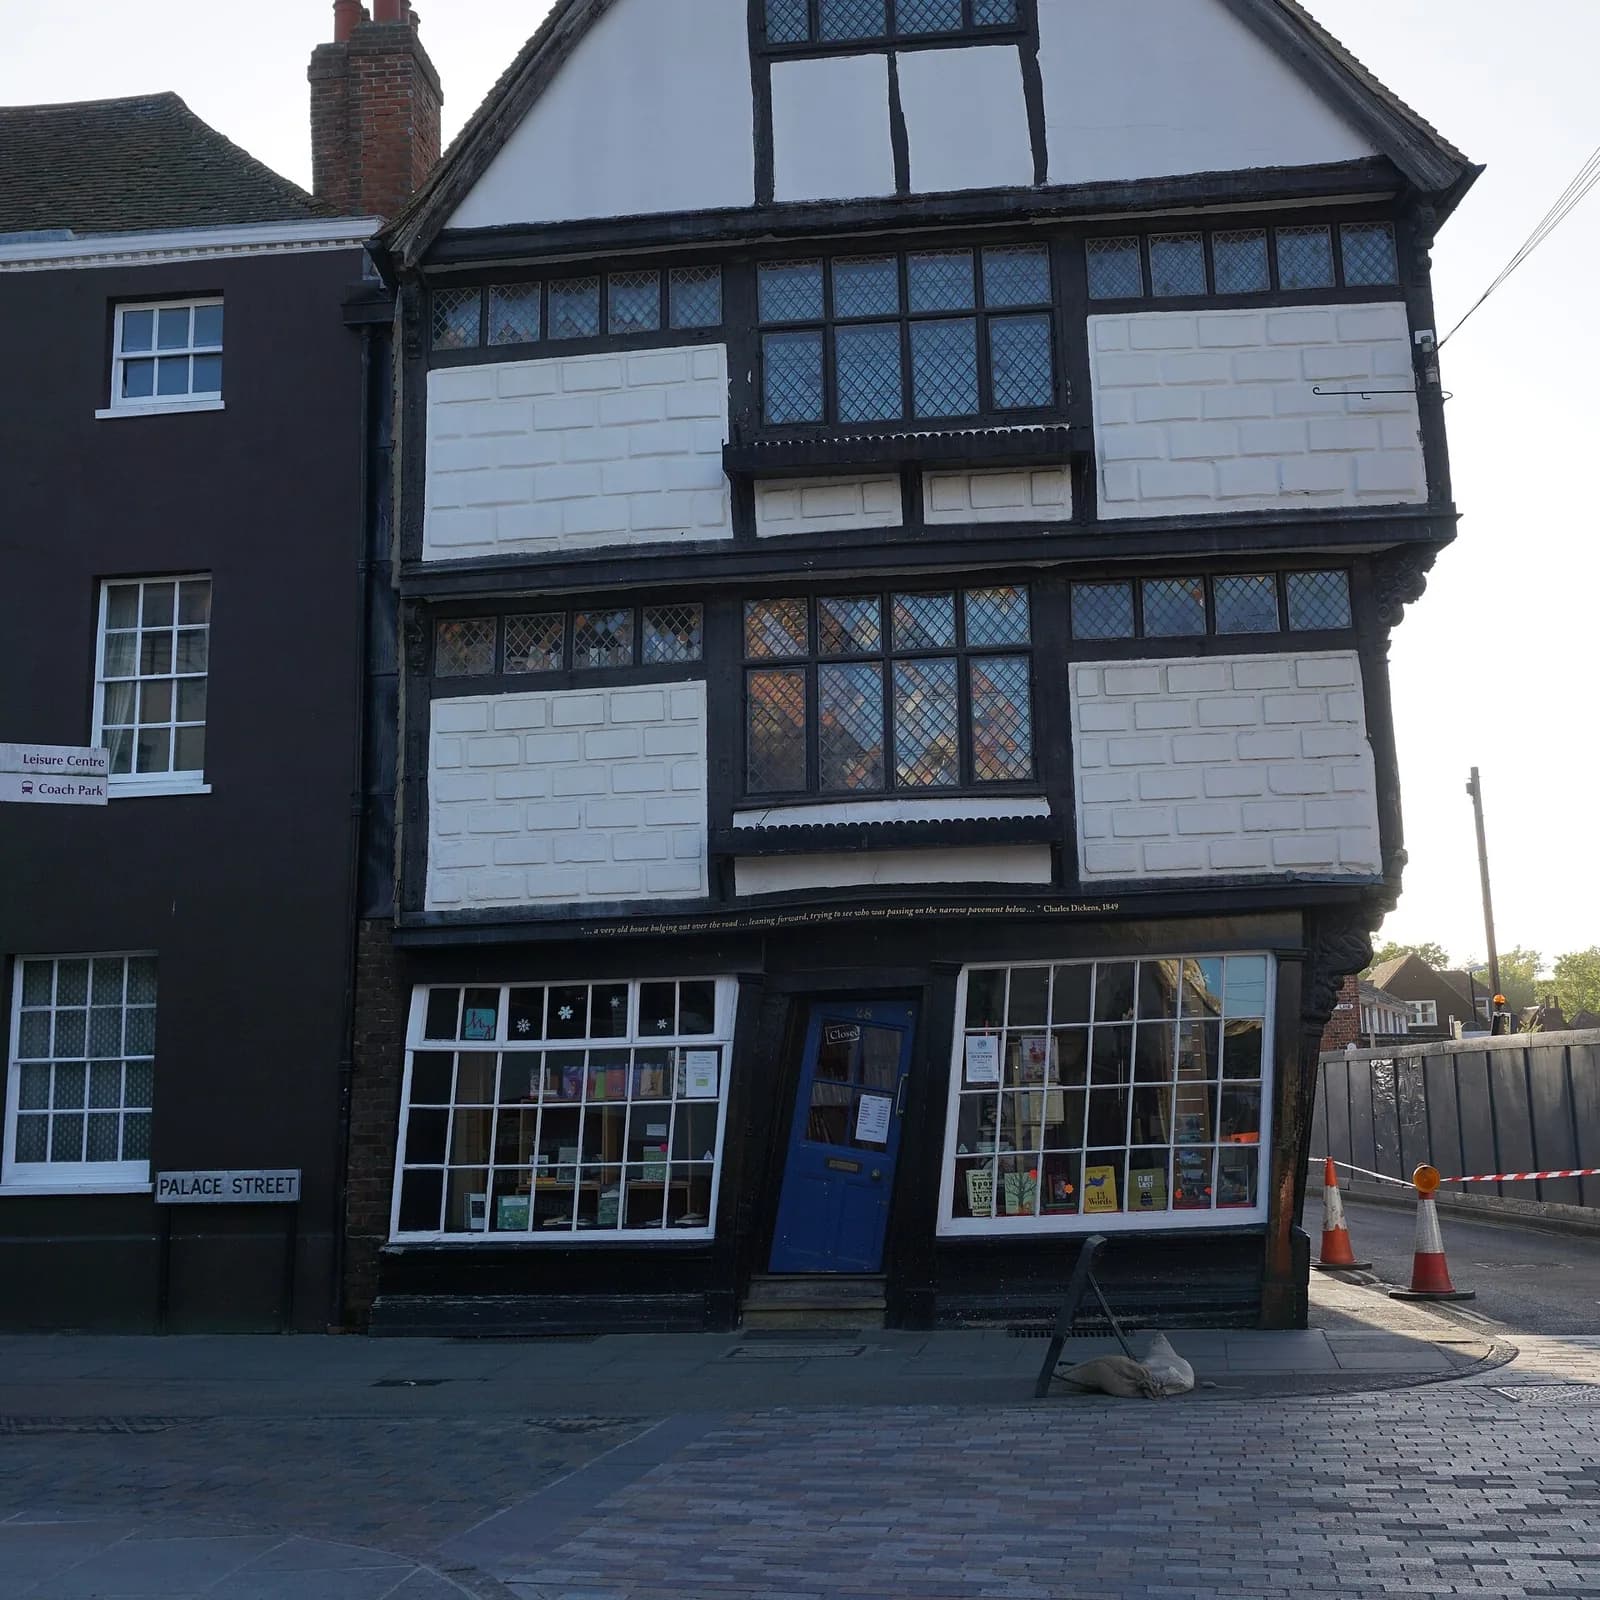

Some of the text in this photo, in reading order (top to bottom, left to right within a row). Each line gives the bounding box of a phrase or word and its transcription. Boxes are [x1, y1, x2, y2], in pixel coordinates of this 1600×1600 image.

[23, 753, 105, 767] Leisure Centre
[38, 783, 103, 796] Coach Park
[599, 927, 616, 936] very
[629, 925, 648, 933] house
[650, 923, 677, 933] bulging
[708, 920, 720, 929] the
[721, 919, 738, 927] road
[776, 912, 809, 926] forward,
[809, 911, 833, 922] trying
[854, 908, 870, 917] who
[886, 906, 914, 918] passing
[925, 905, 937, 914] the
[939, 906, 967, 914] narrow
[967, 905, 1004, 916] pavement
[1043, 903, 1069, 912] Charles
[1071, 903, 1101, 913] Dickens,
[1102, 902, 1119, 911] 1849
[856, 1007, 872, 1019] 28
[159, 1177, 296, 1196] PALACE STREET
[1088, 1197, 1112, 1205] Words
